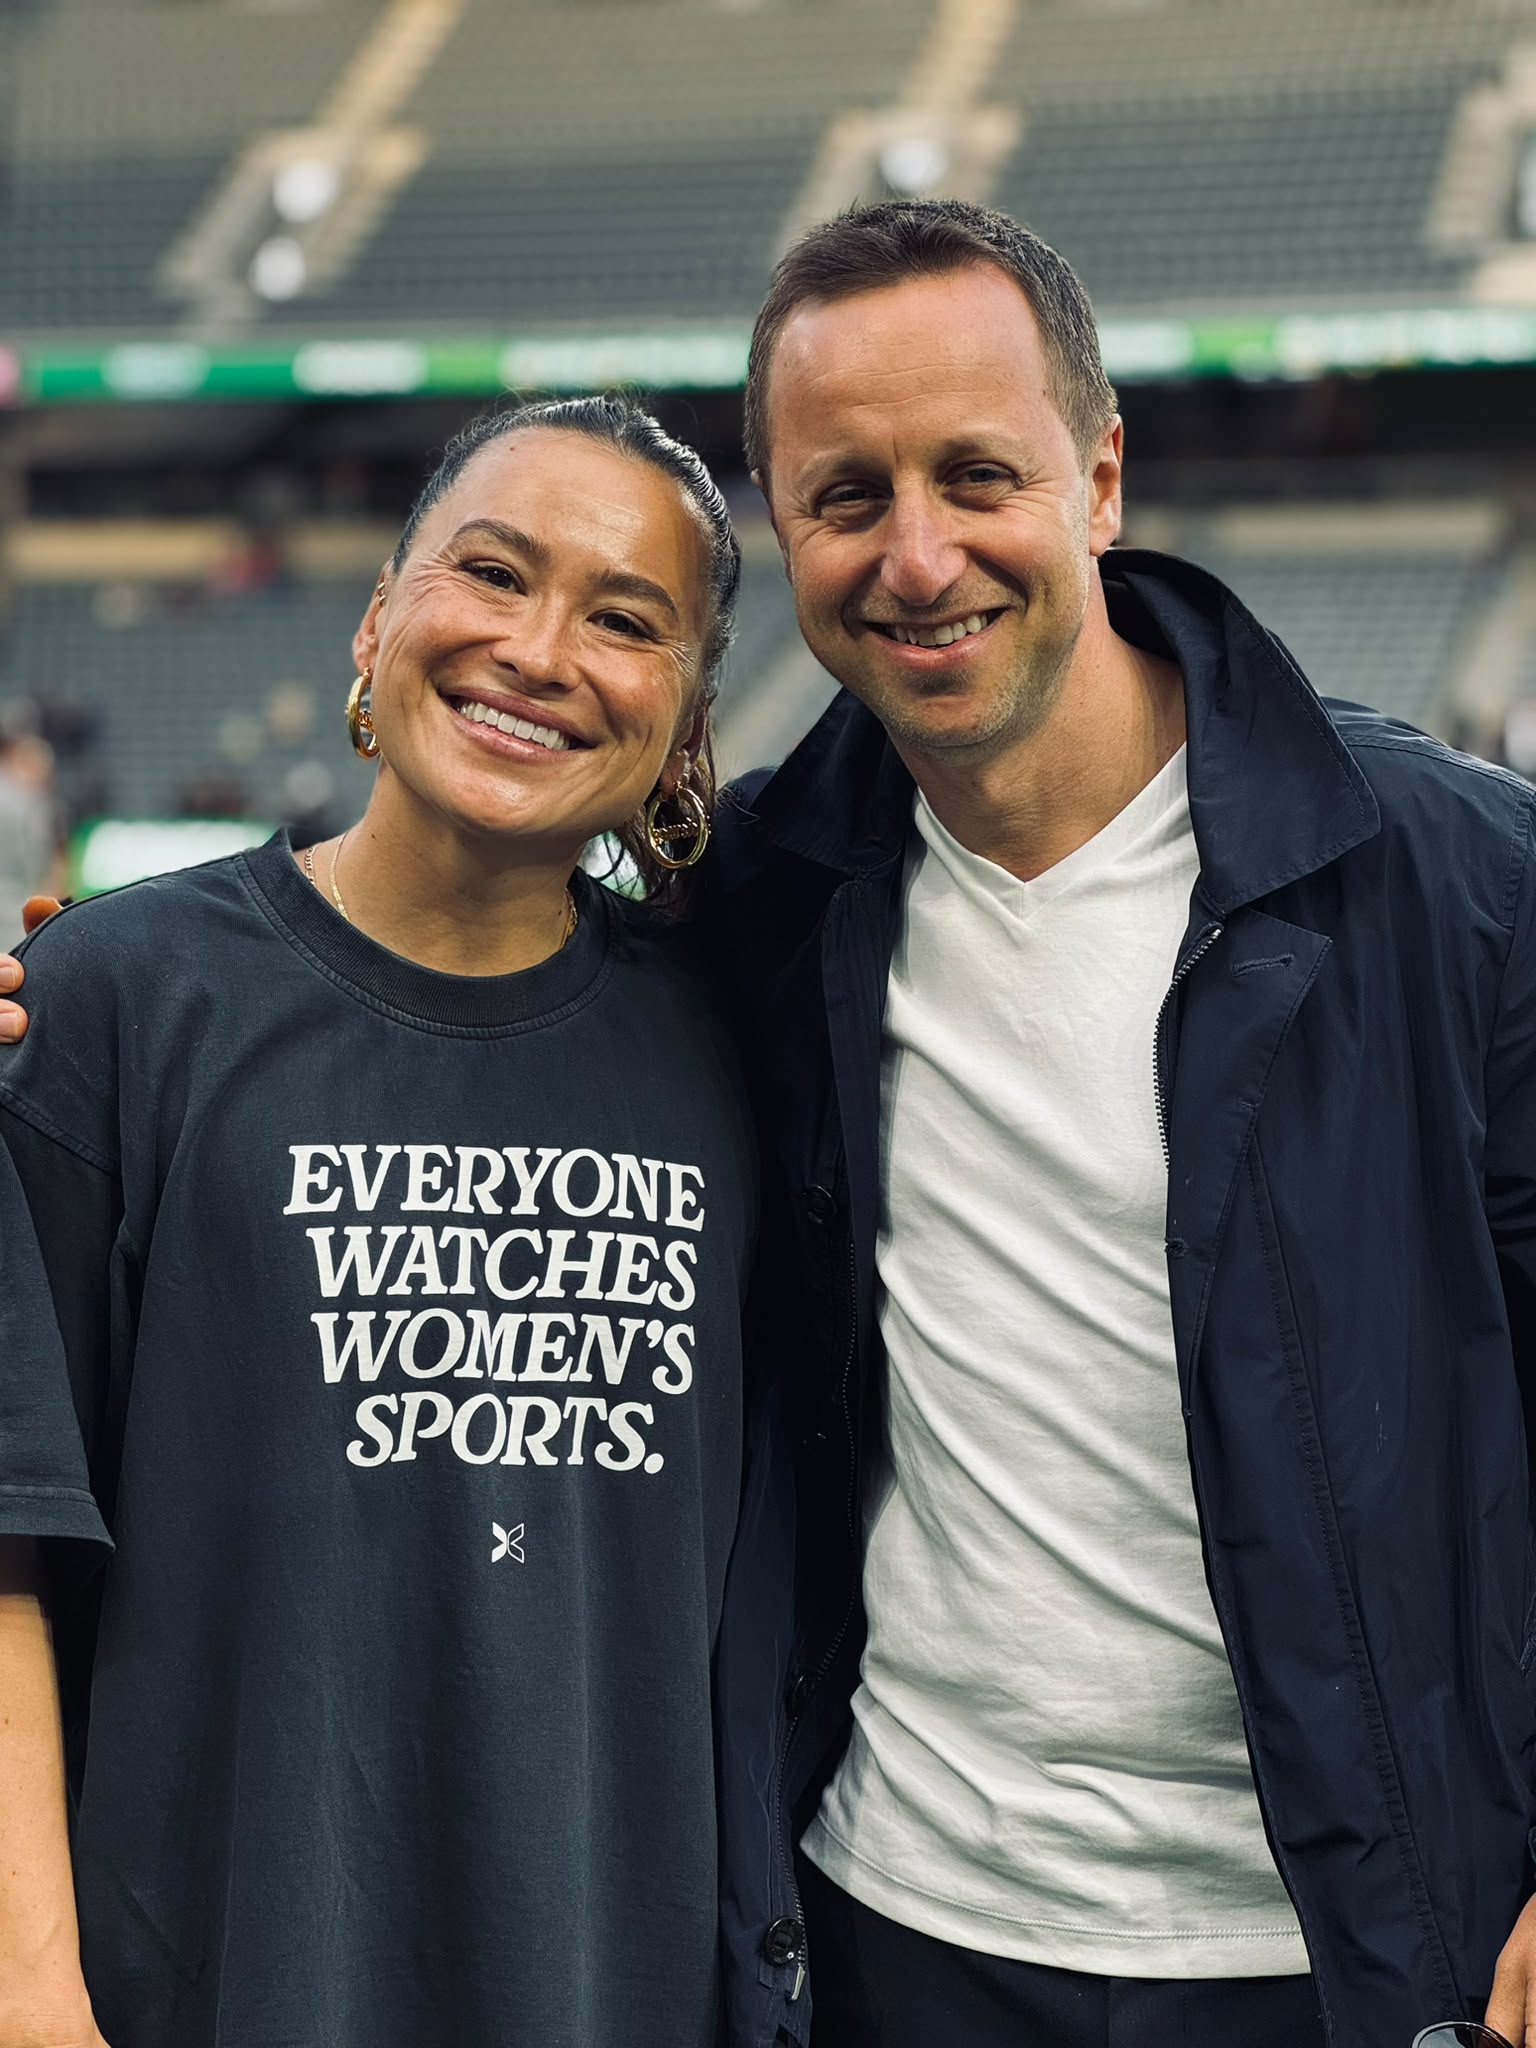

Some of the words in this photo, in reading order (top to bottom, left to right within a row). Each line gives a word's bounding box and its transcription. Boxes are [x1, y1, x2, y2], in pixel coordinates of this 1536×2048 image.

[283, 1144, 705, 1232] EVERYONE
[305, 1225, 698, 1312] WATCHES
[310, 1307, 696, 1395] WOMEN’S
[345, 1390, 665, 1475] SPORTS.
